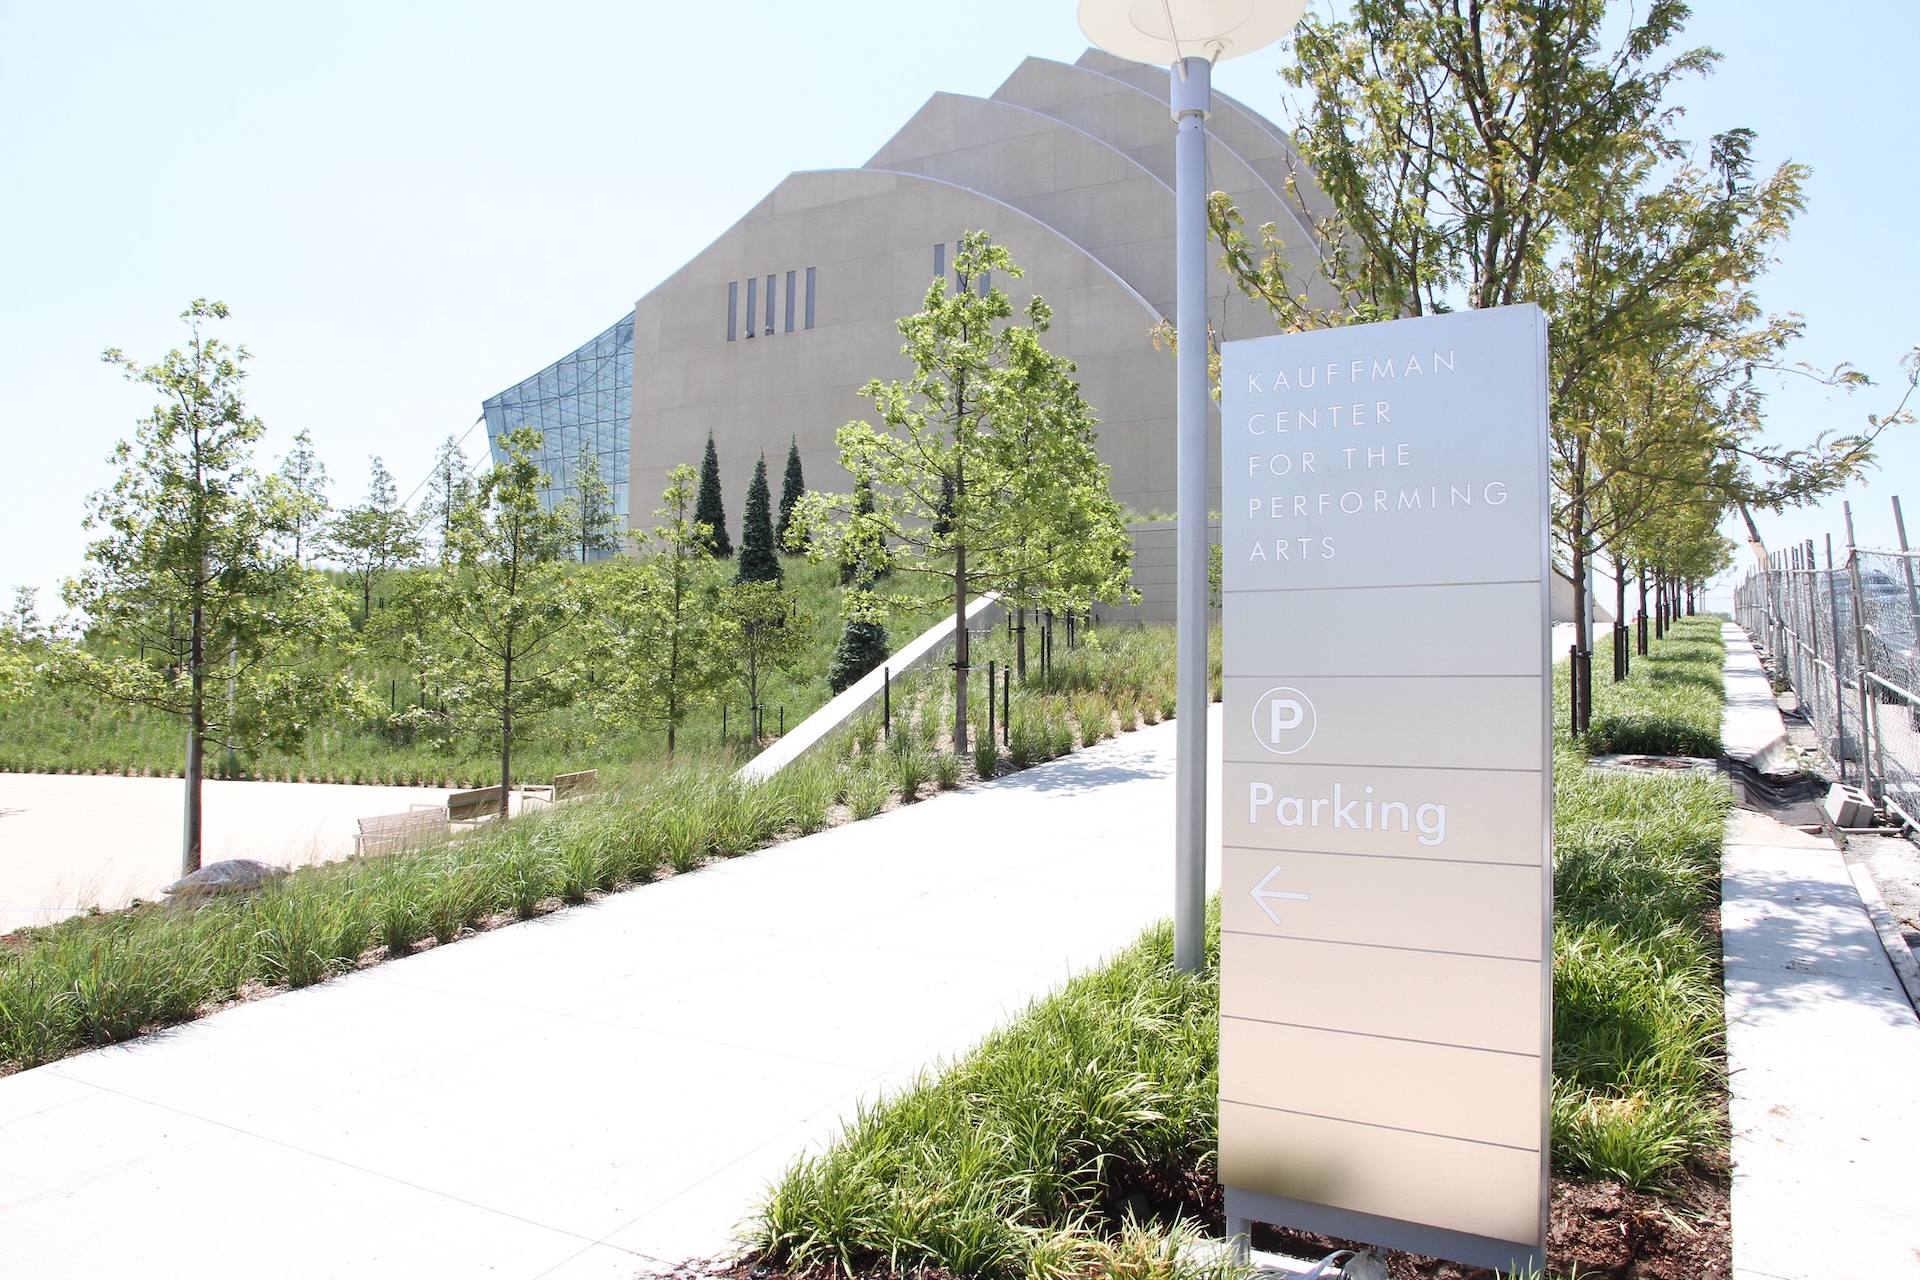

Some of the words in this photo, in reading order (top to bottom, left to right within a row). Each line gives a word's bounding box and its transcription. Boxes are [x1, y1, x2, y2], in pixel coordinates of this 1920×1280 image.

[1248, 349, 1455, 394] KAUFFMAN
[1248, 401, 1391, 435] CENTER
[1249, 451, 1316, 478] FOR
[1342, 443, 1411, 470] THE
[1249, 481, 1508, 520] PERFORMING
[1248, 536, 1335, 563] ARTS
[1269, 698, 1304, 744] P
[1249, 781, 1447, 847] Parking
